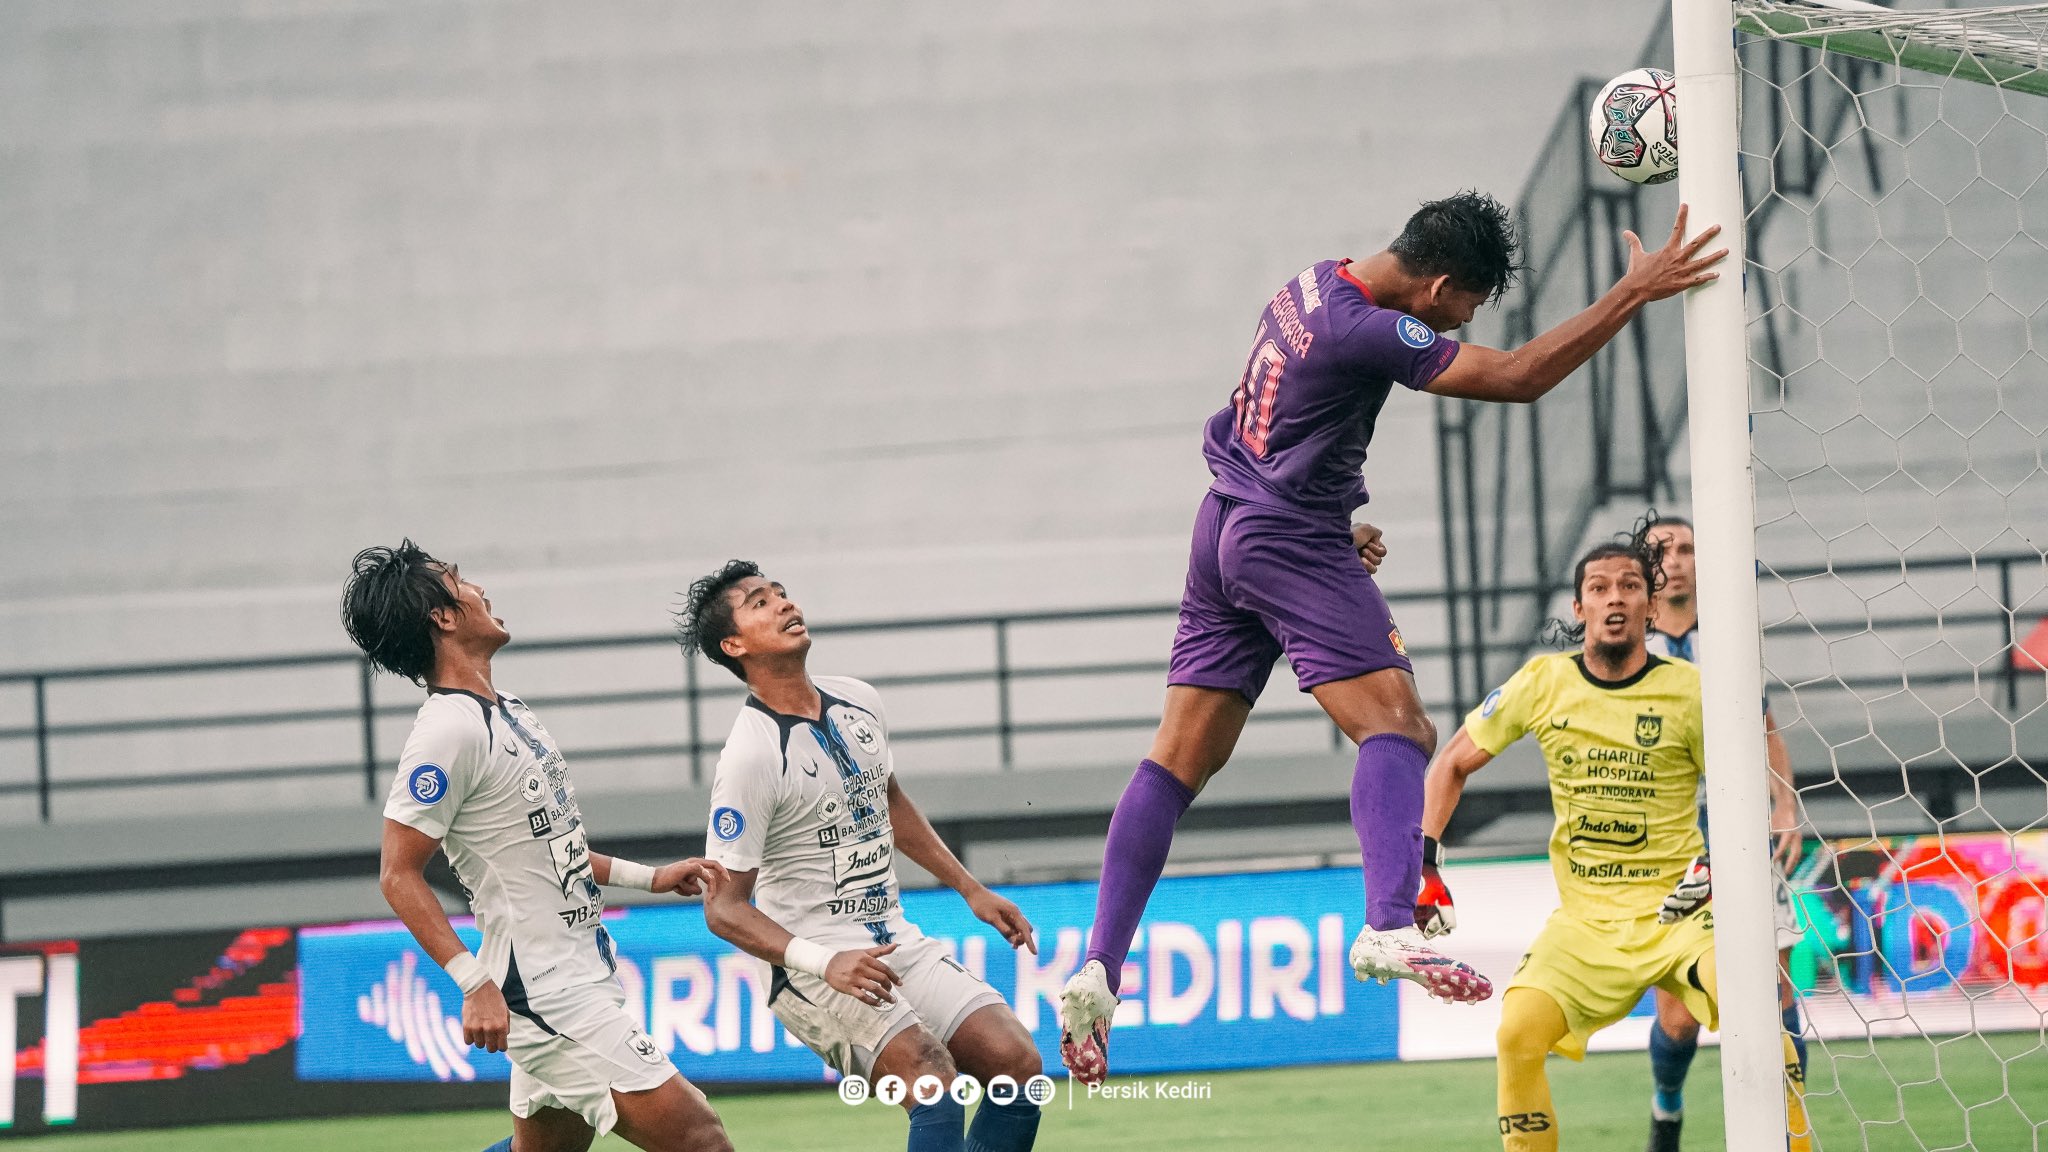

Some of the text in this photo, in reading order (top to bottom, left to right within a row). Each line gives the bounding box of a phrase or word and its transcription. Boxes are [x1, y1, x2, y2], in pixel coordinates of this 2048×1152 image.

[1588, 747, 1650, 767] CHARLIE
[843, 763, 885, 794] CHARLIE
[1587, 764, 1657, 782] HOSPITAL
[1601, 785, 1657, 799] INDORAYA
[821, 828, 839, 843] BI
